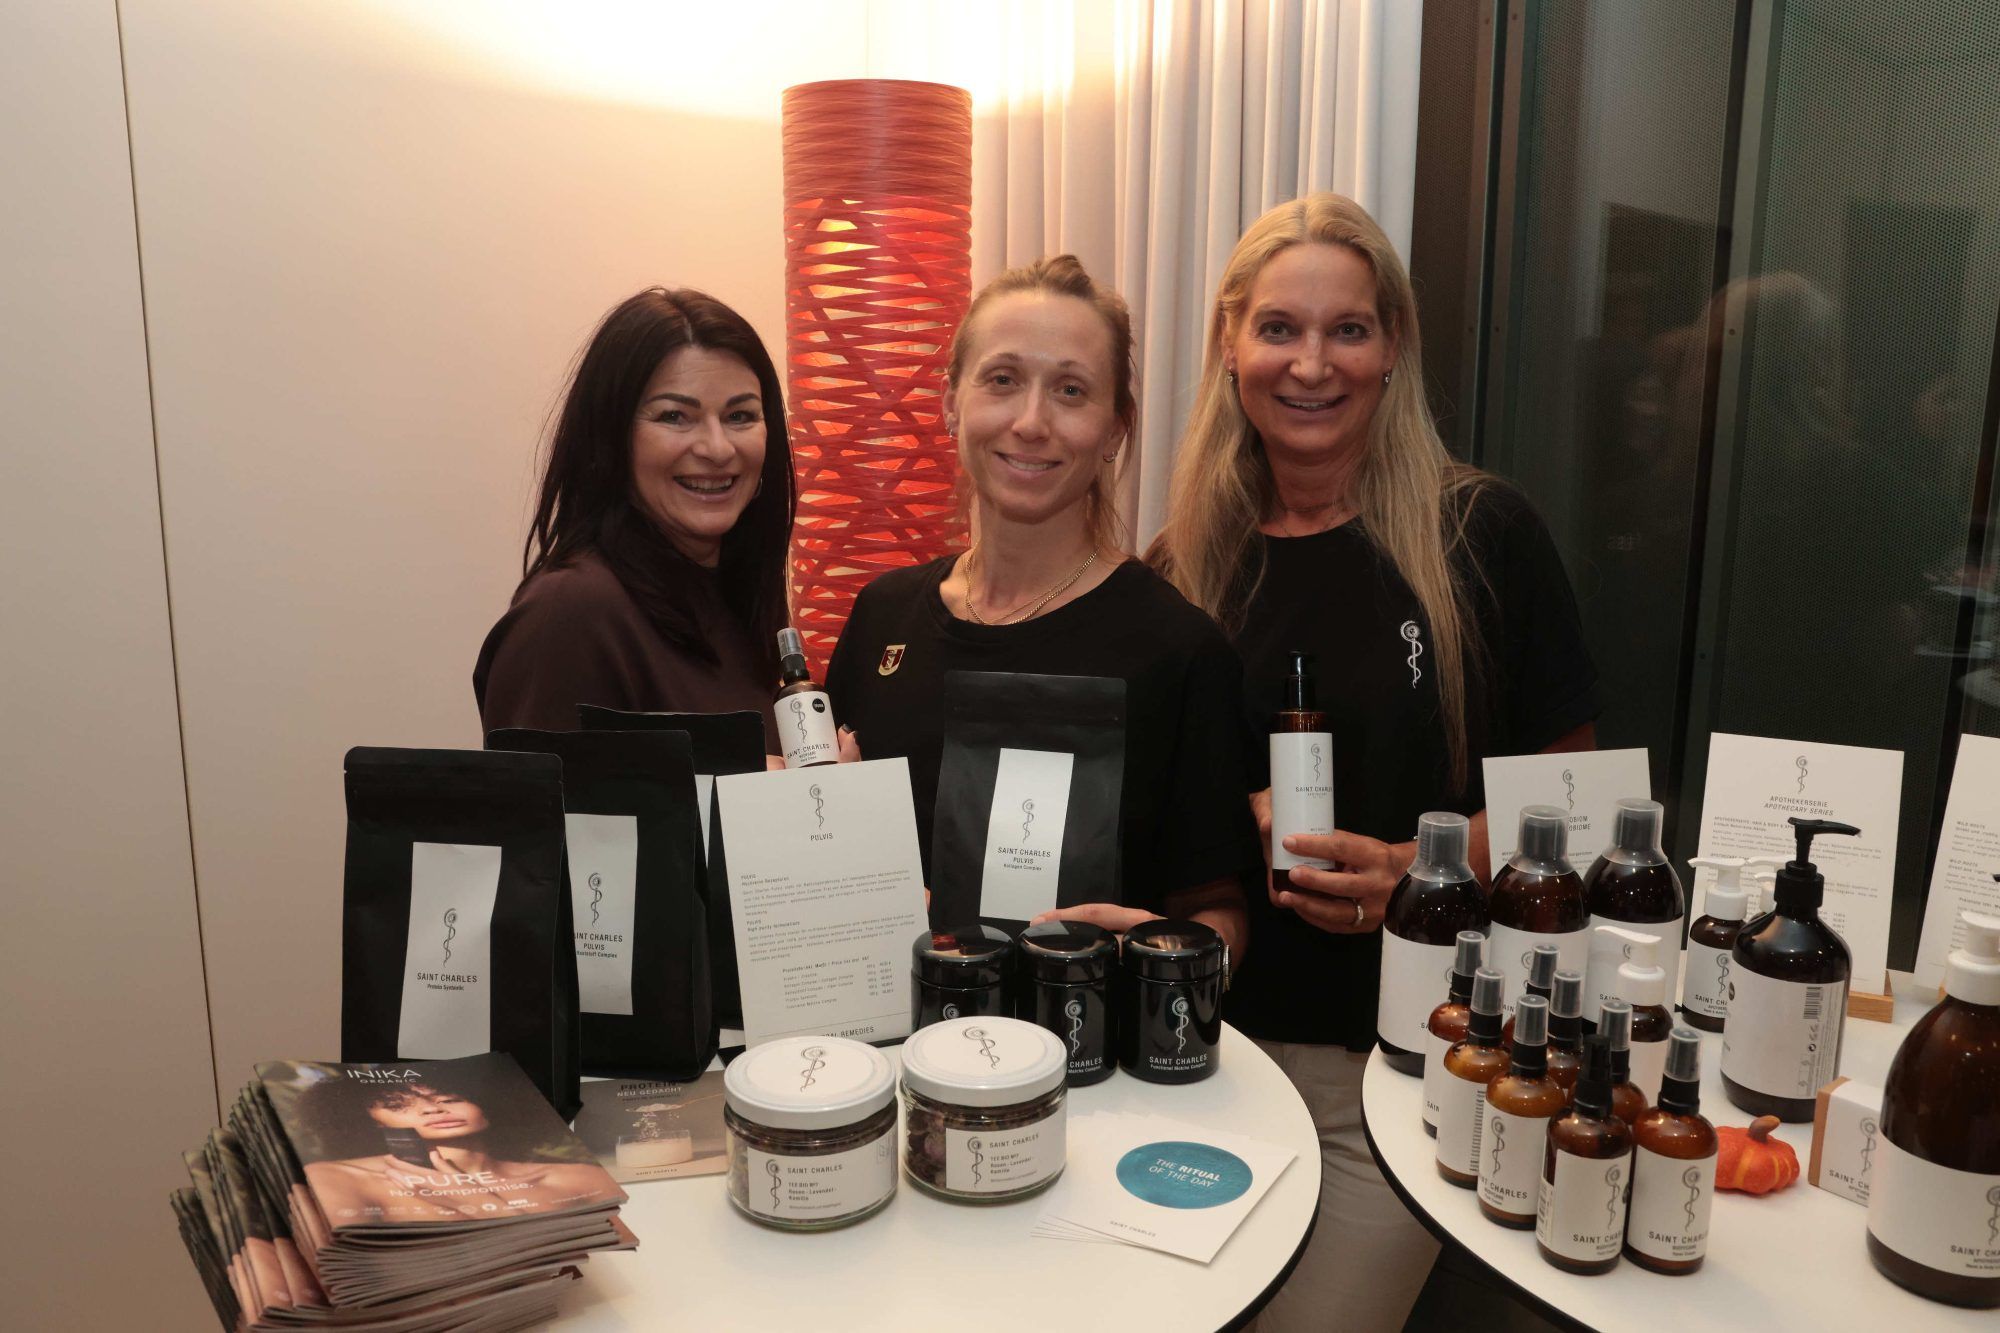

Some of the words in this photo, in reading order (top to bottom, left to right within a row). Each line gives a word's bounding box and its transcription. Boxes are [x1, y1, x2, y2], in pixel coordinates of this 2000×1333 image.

[787, 748, 801, 759] SAINT
[803, 743, 829, 753] CHARLES
[1763, 803, 1807, 813] APOTHECARY
[1809, 808, 1834, 817] SERIES
[811, 832, 834, 842] PULVIS
[998, 846, 1018, 855] SAINT
[1019, 848, 1051, 858] CHARLES
[589, 933, 623, 943] CHARLES
[583, 942, 605, 951] PULVIS
[416, 972, 439, 981] SAINT
[440, 974, 478, 983] CHARLES
[1695, 994, 1713, 1005] SAINT
[840, 1026, 874, 1037] REMEDIES
[1070, 1056, 1103, 1069] CHARLES
[1149, 1056, 1173, 1065] SAINT
[1175, 1053, 1208, 1066] CHARLES
[346, 1069, 422, 1078] INIKA
[620, 1081, 678, 1091] PROTEIN
[617, 1089, 636, 1097] NEU
[1013, 1132, 1039, 1146] CHARLES
[811, 1164, 842, 1174] CHARLES
[1156, 1158, 1178, 1169] THE
[1178, 1165, 1221, 1182] RITUAL
[402, 1170, 507, 1188] PURE.
[1148, 1165, 1166, 1174] OF
[1167, 1170, 1190, 1181] THE
[1190, 1177, 1216, 1188] DAY
[1829, 1169, 1855, 1184] SAINT
[390, 1187, 416, 1198] No
[418, 1181, 535, 1198] Compromise.
[1490, 1182, 1528, 1199] CHARLES
[1572, 1234, 1600, 1244] SAINT
[1648, 1231, 1677, 1244] SAINT
[1950, 1245, 1980, 1257] SAINT
